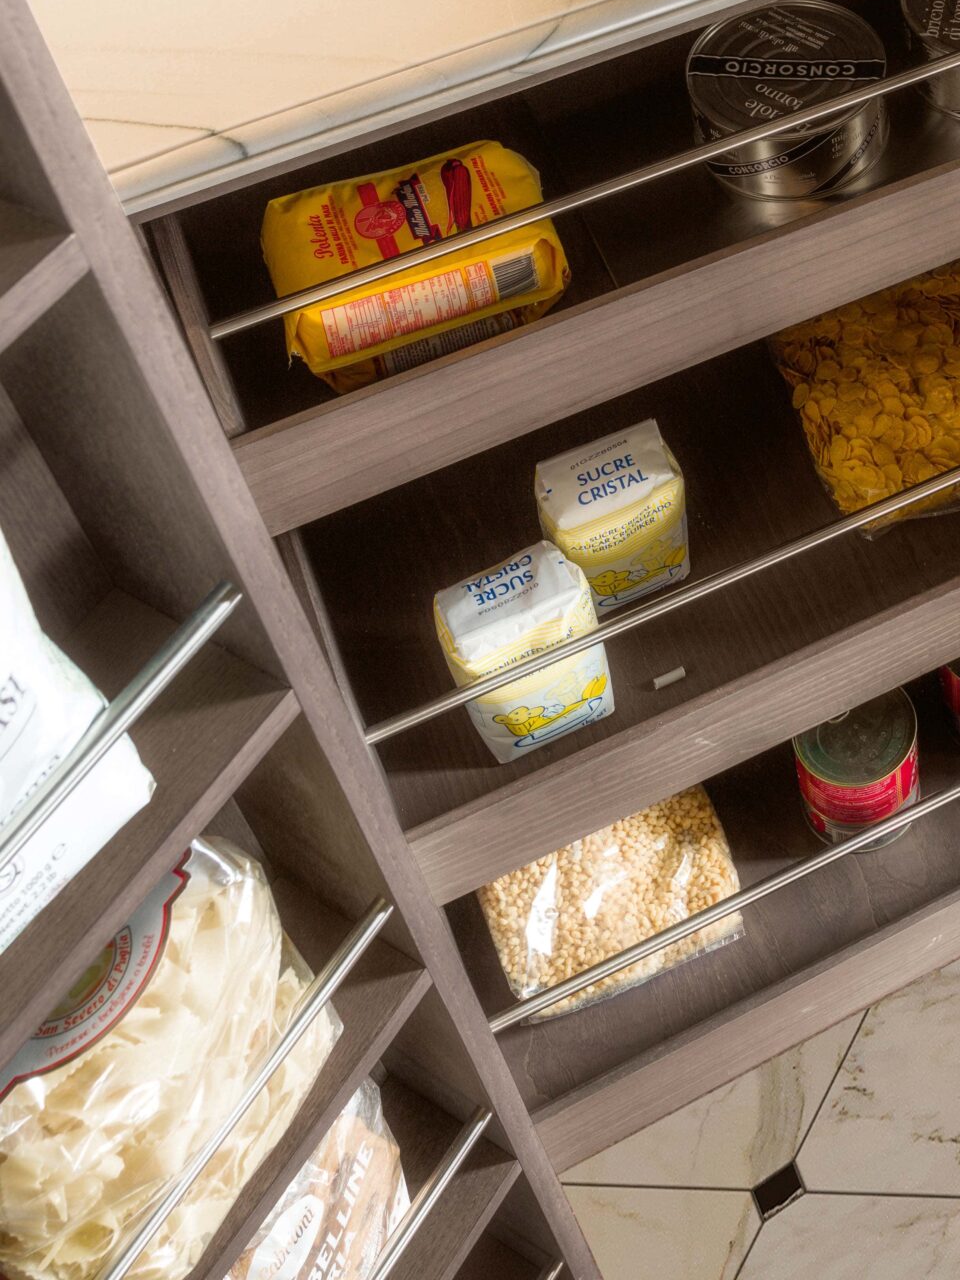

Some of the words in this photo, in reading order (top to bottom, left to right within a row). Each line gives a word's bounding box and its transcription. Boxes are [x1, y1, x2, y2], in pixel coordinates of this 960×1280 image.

[725, 60, 856, 77] CONSORCIO
[755, 83, 804, 111] tonno
[727, 153, 790, 176] CONSORCIO
[310, 214, 334, 260] Polenta
[411, 208, 430, 237] Molino
[576, 453, 636, 487] SUCRE
[577, 472, 648, 506] CRISTAL
[589, 528, 623, 543] SUCRE
[475, 570, 534, 607] SUCRE
[20, 870, 45, 896] 1000
[63, 993, 106, 1030] Severo
[103, 973, 119, 992] di
[114, 933, 130, 975] Puglia
